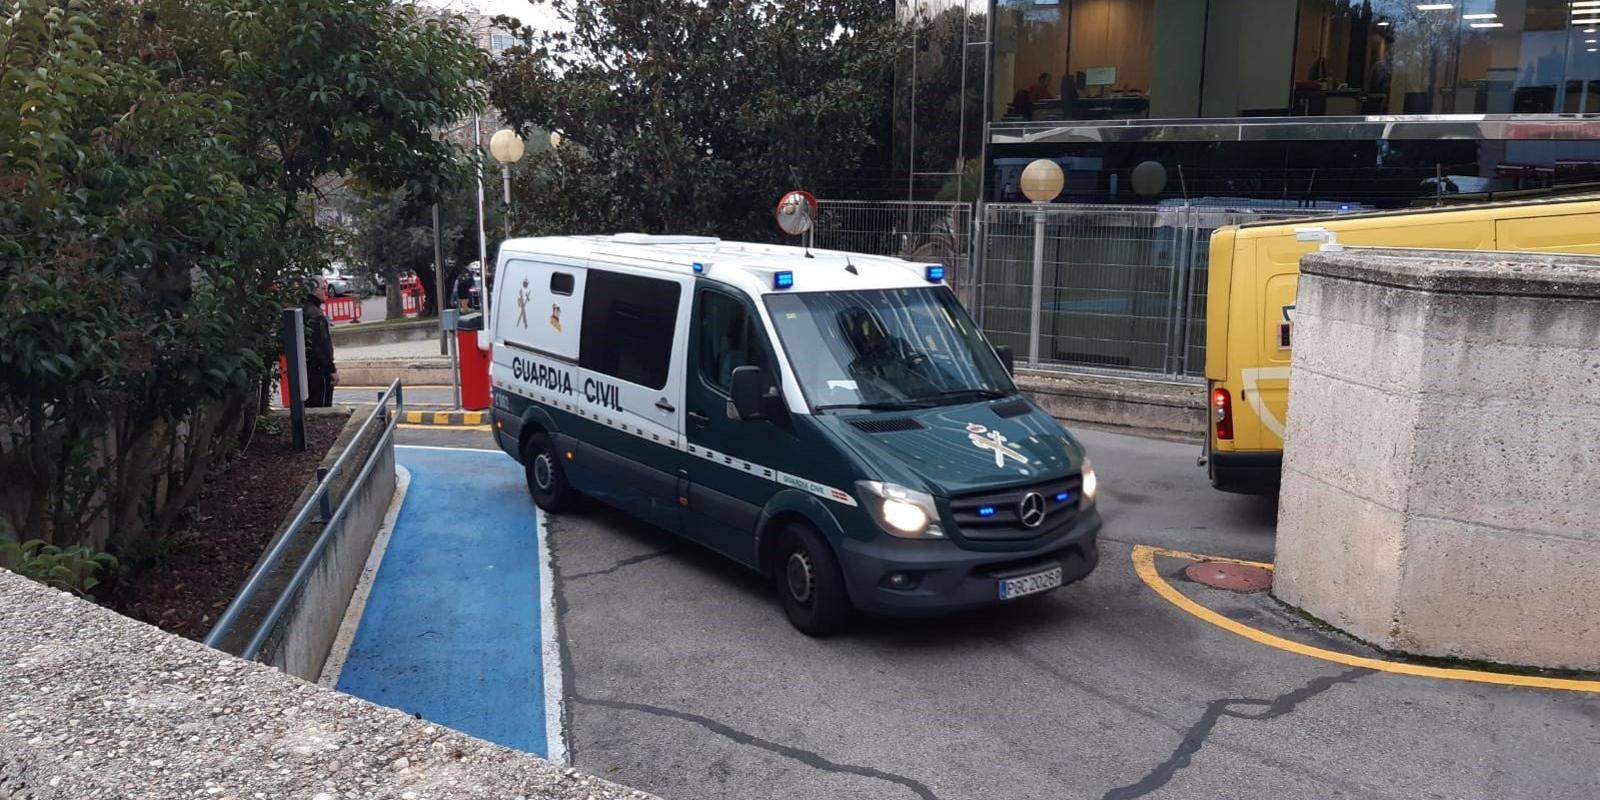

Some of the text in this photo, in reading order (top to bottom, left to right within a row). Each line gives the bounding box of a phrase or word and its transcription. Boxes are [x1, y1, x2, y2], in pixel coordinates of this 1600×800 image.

[512, 356, 623, 412] GUARDIA CIVIL
[783, 475, 825, 495] GUARDIA CIVIL
